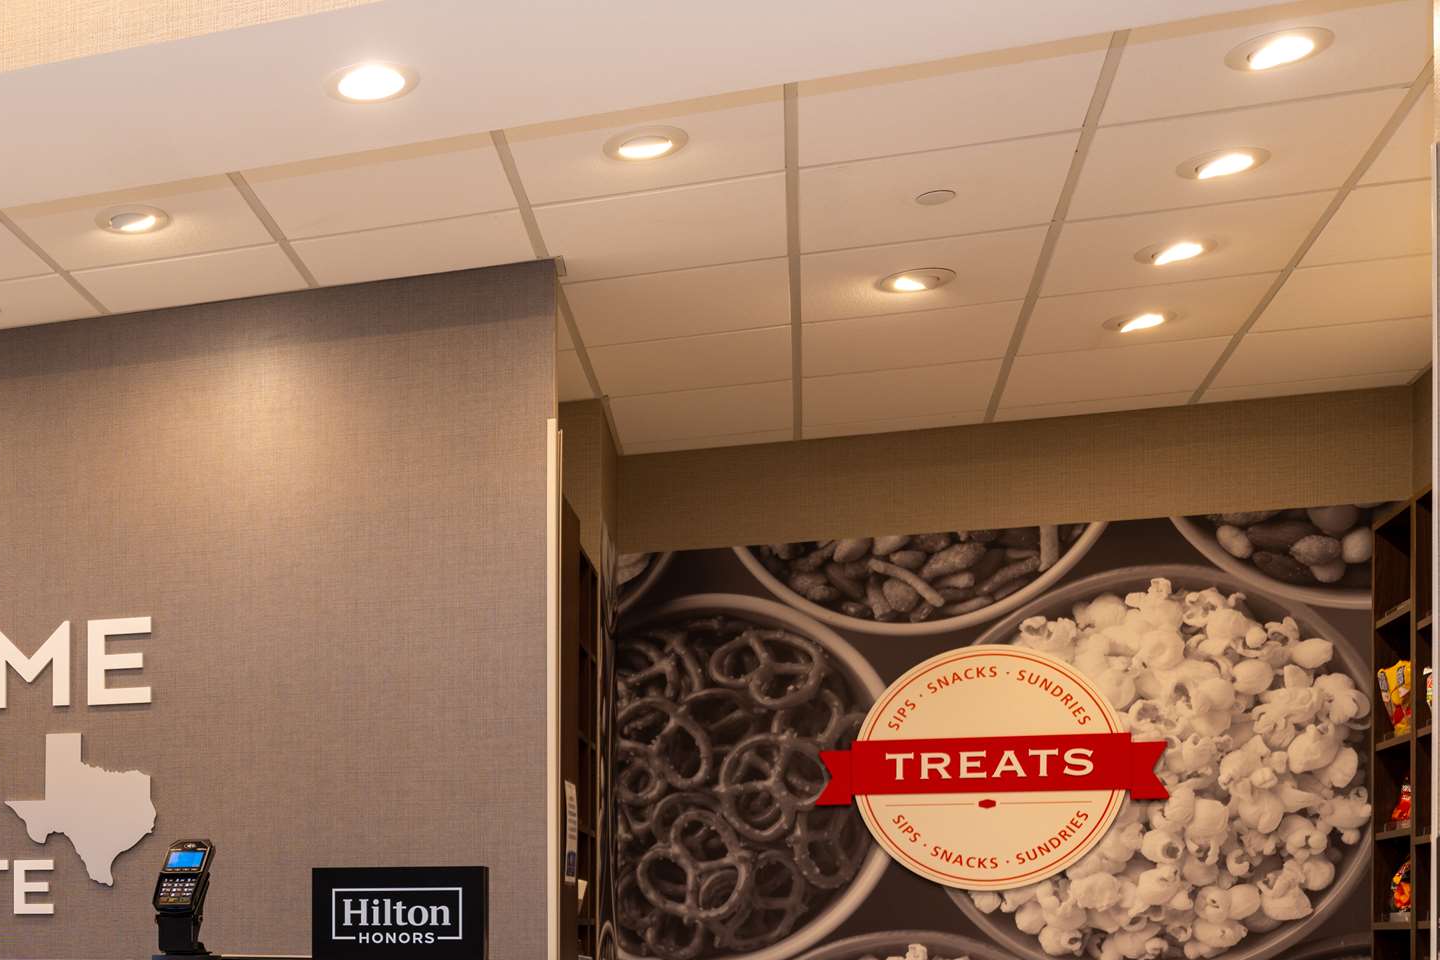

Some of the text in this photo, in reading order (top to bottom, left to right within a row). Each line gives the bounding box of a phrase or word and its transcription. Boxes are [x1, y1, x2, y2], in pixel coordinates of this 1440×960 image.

[887, 665, 1091, 732] SIPS SNACKS SUNDRIES
[885, 748, 1094, 781] TREATS
[892, 810, 1089, 869] SIPS SNACKS SUNDRIES
[342, 898, 451, 926] Hilton
[358, 932, 435, 944] HONORS
